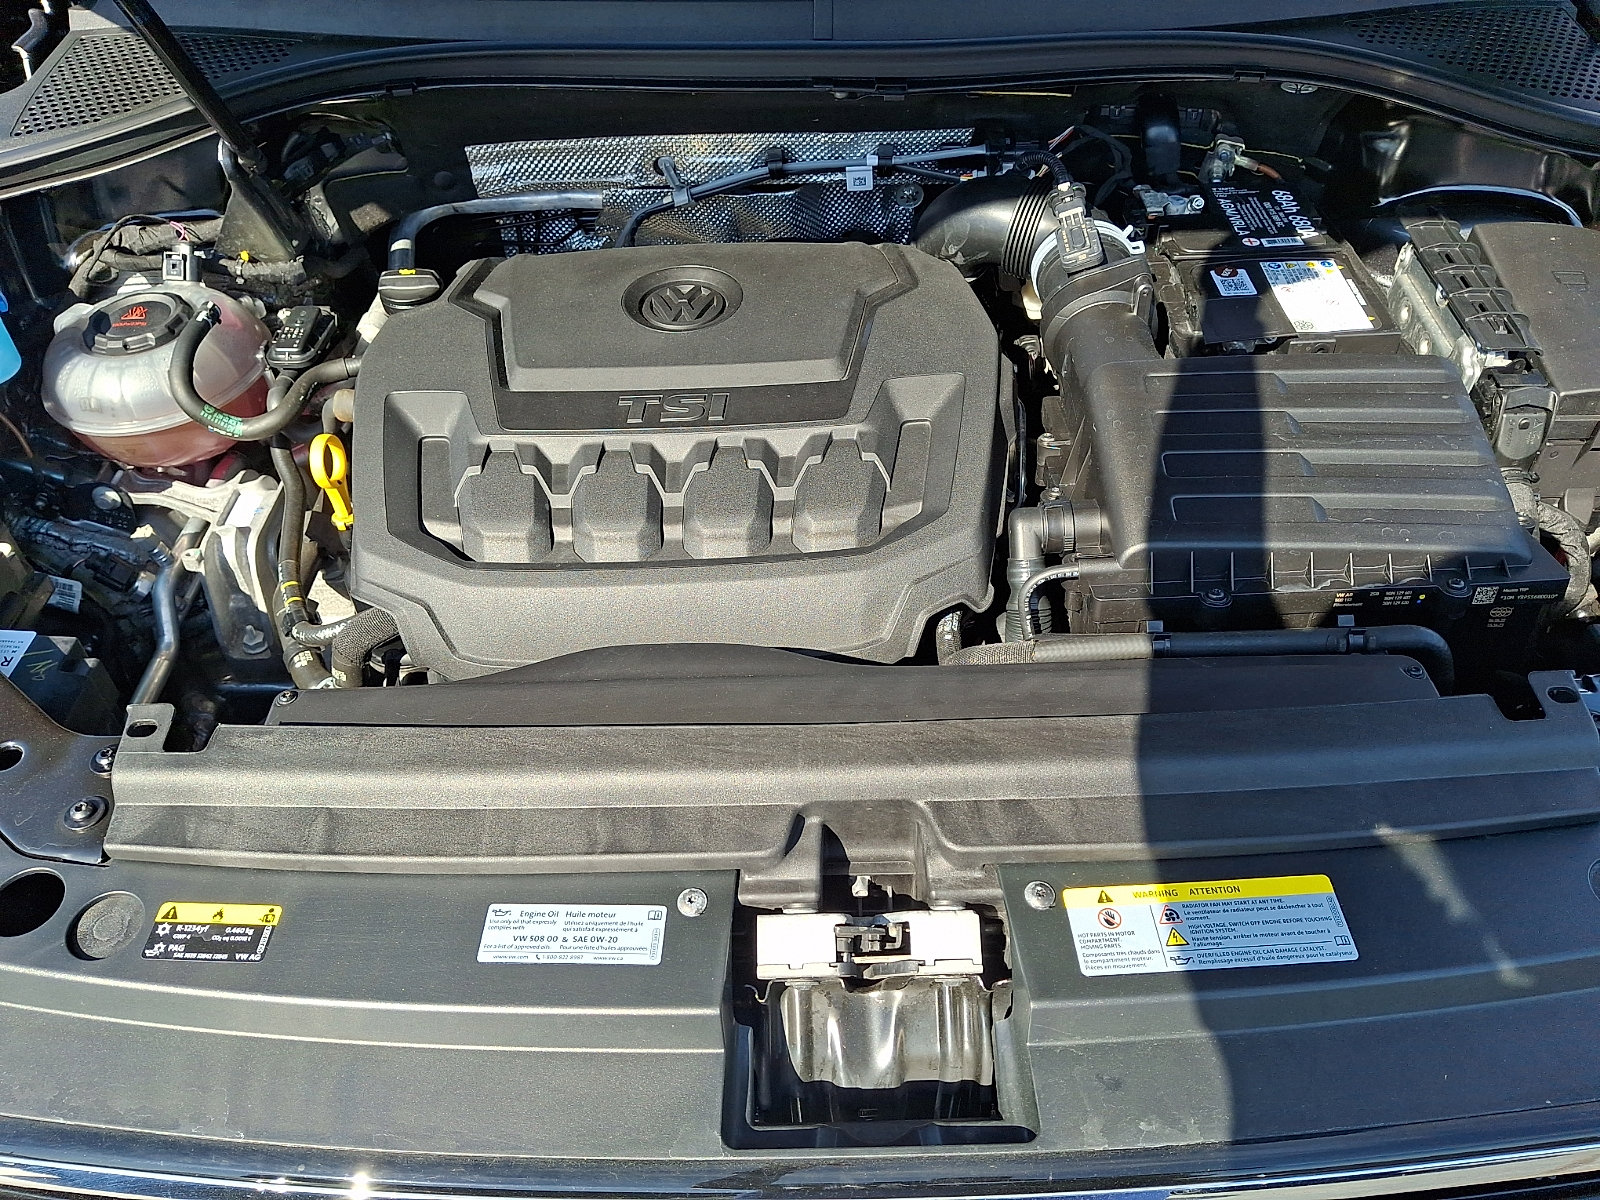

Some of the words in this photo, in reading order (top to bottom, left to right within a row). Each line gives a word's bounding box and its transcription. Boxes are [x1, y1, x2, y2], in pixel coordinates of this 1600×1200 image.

[1271, 190, 1300, 213] 68Ah
[1288, 215, 1319, 239] 680A
[618, 393, 730, 423] TSI
[1132, 889, 1179, 898] WARNING
[1190, 886, 1241, 896] ATTENTION
[520, 911, 546, 919] Engine
[176, 925, 210, 934] R-1234yf
[246, 927, 254, 935] kg
